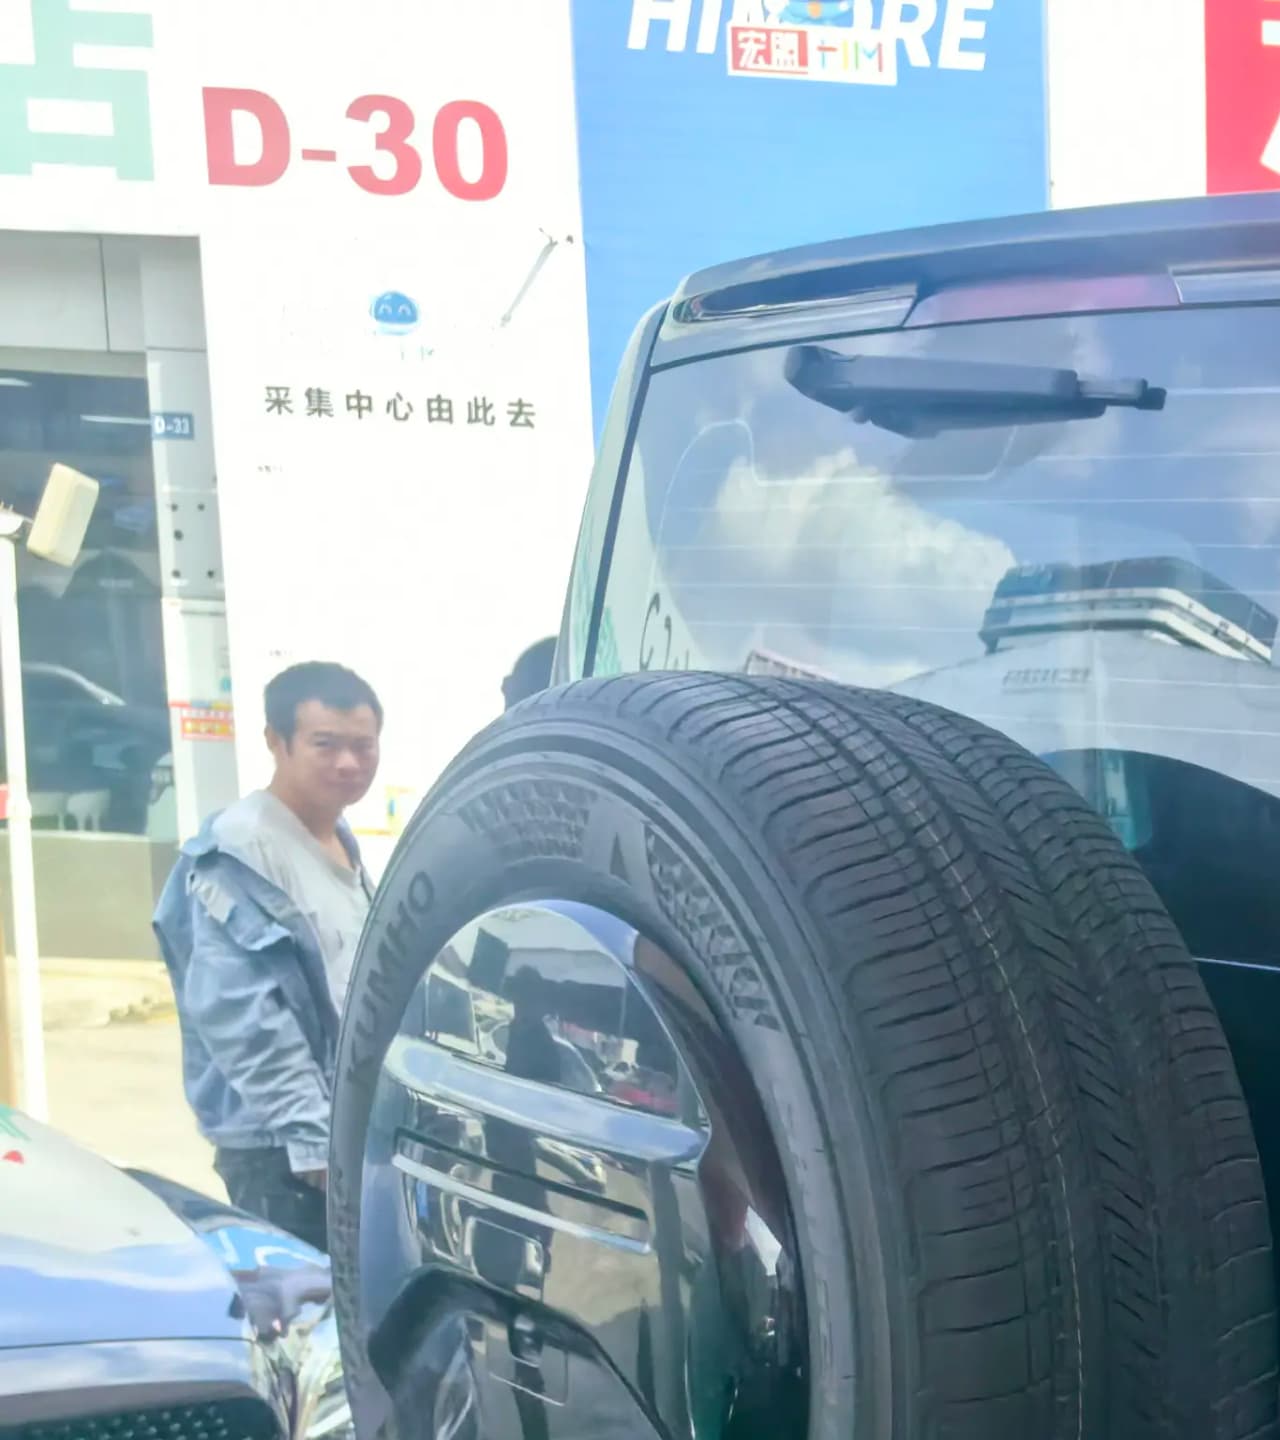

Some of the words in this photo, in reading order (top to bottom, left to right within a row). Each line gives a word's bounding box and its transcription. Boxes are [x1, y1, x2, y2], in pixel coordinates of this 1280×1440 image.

[202, 86, 508, 201] D-30
[264, 385, 537, 429] 采集中心由此去
